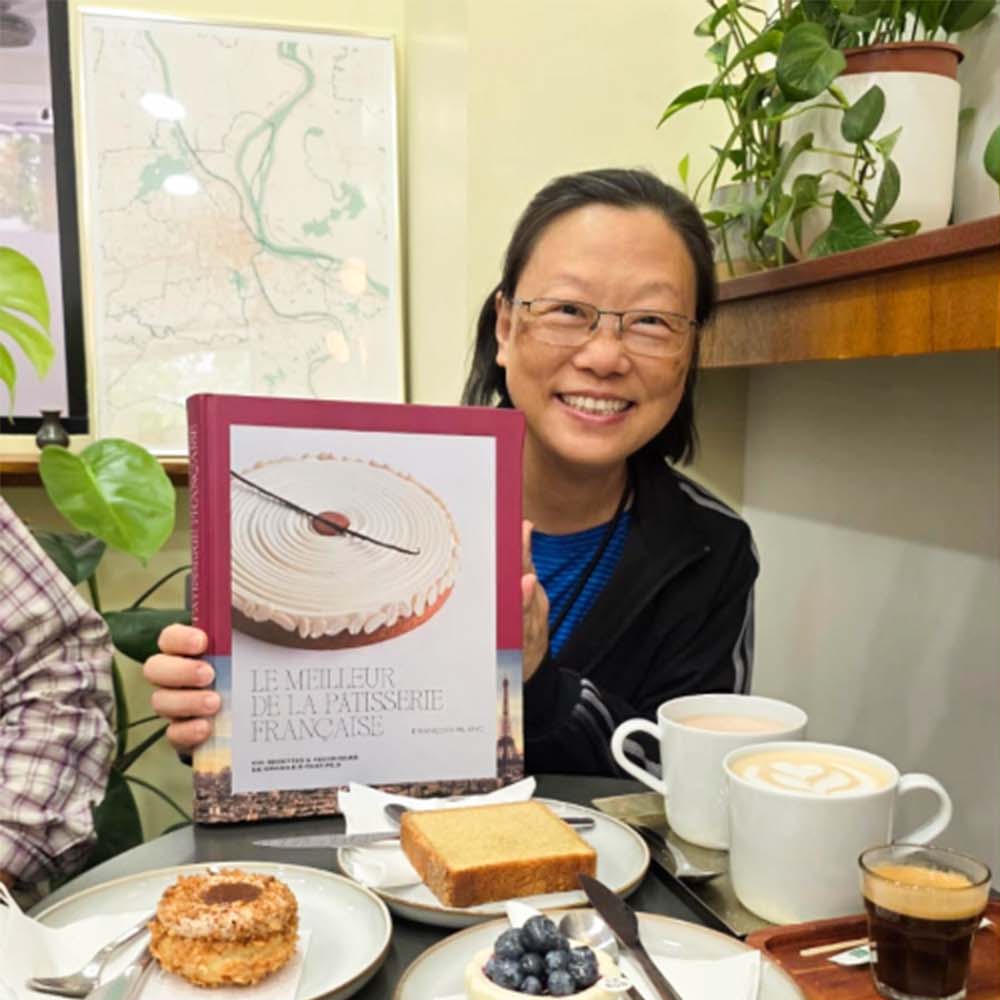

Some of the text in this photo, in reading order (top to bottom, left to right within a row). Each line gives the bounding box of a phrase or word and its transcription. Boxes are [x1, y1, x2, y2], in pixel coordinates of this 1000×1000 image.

[251, 667, 395, 693] LE MEILLEUR
[251, 694, 281, 717] DE
[288, 693, 318, 716] LA
[251, 715, 385, 743] FRANÇAISE
